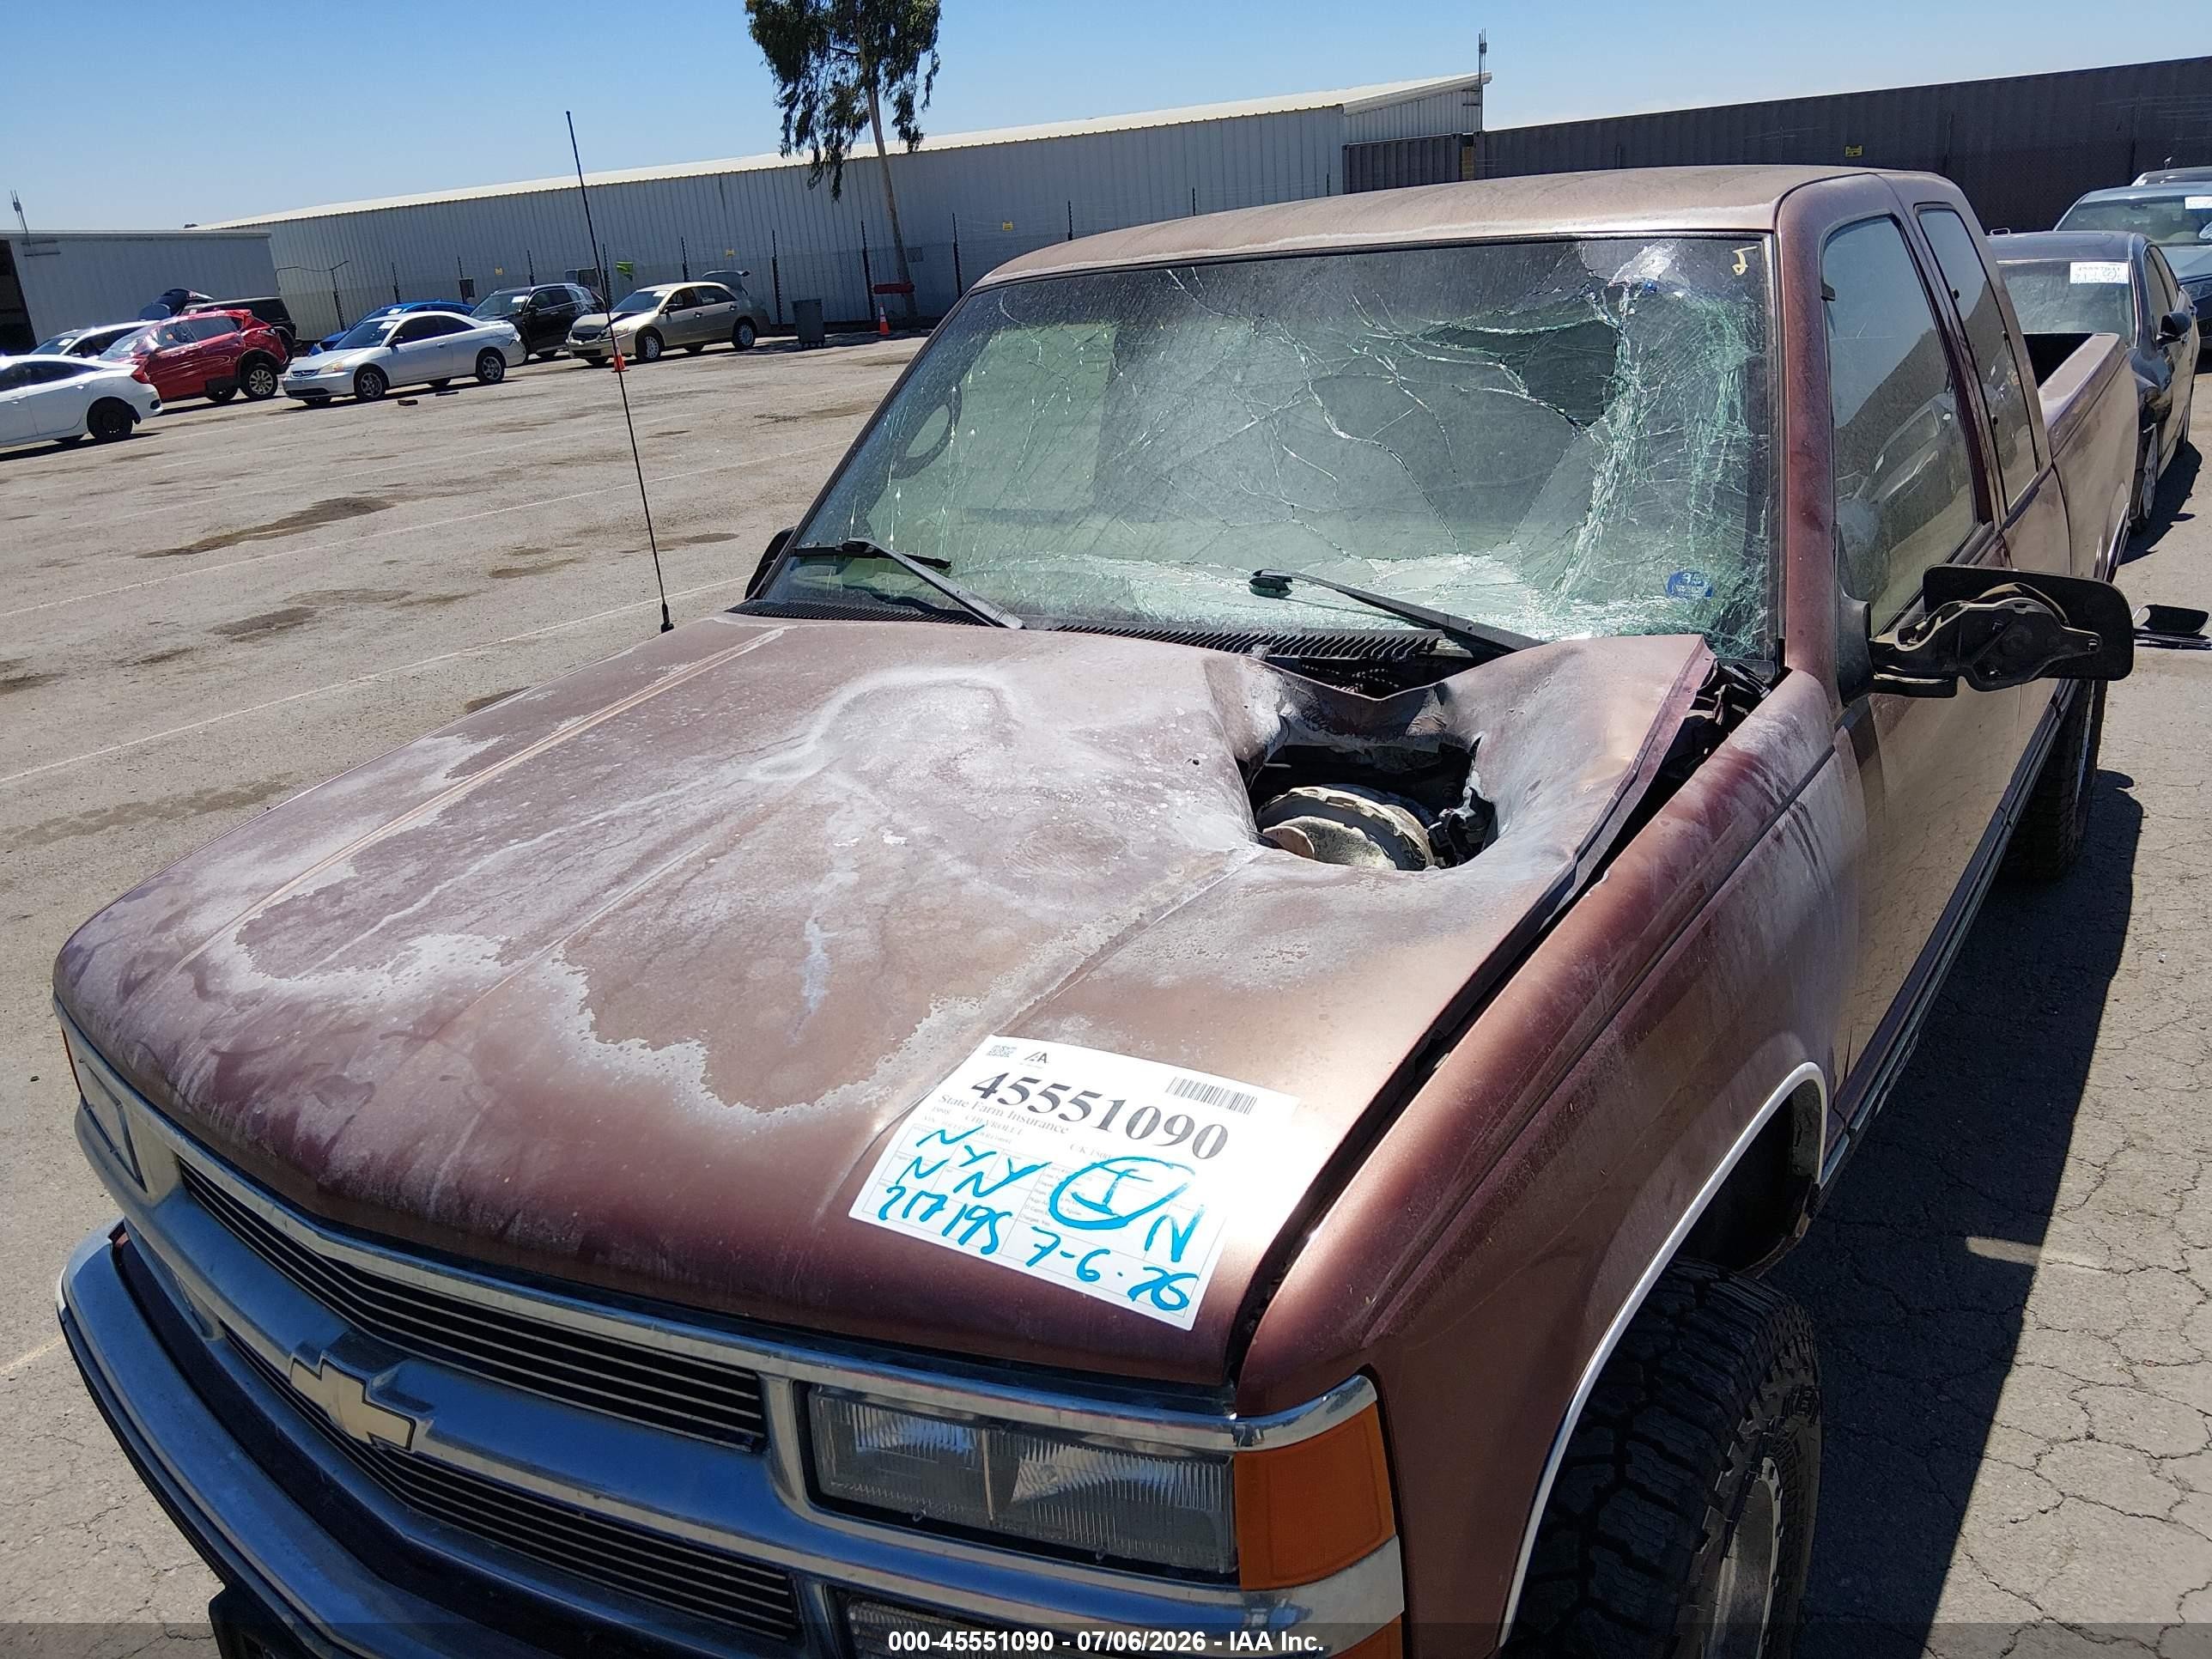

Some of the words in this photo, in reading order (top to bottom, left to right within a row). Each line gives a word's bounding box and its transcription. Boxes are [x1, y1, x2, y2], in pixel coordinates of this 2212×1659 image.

[941, 1094, 969, 1108] State
[971, 1101, 1005, 1117] Farm
[1007, 1109, 1070, 1133] Insurance
[971, 1073, 1228, 1159] 45551090
